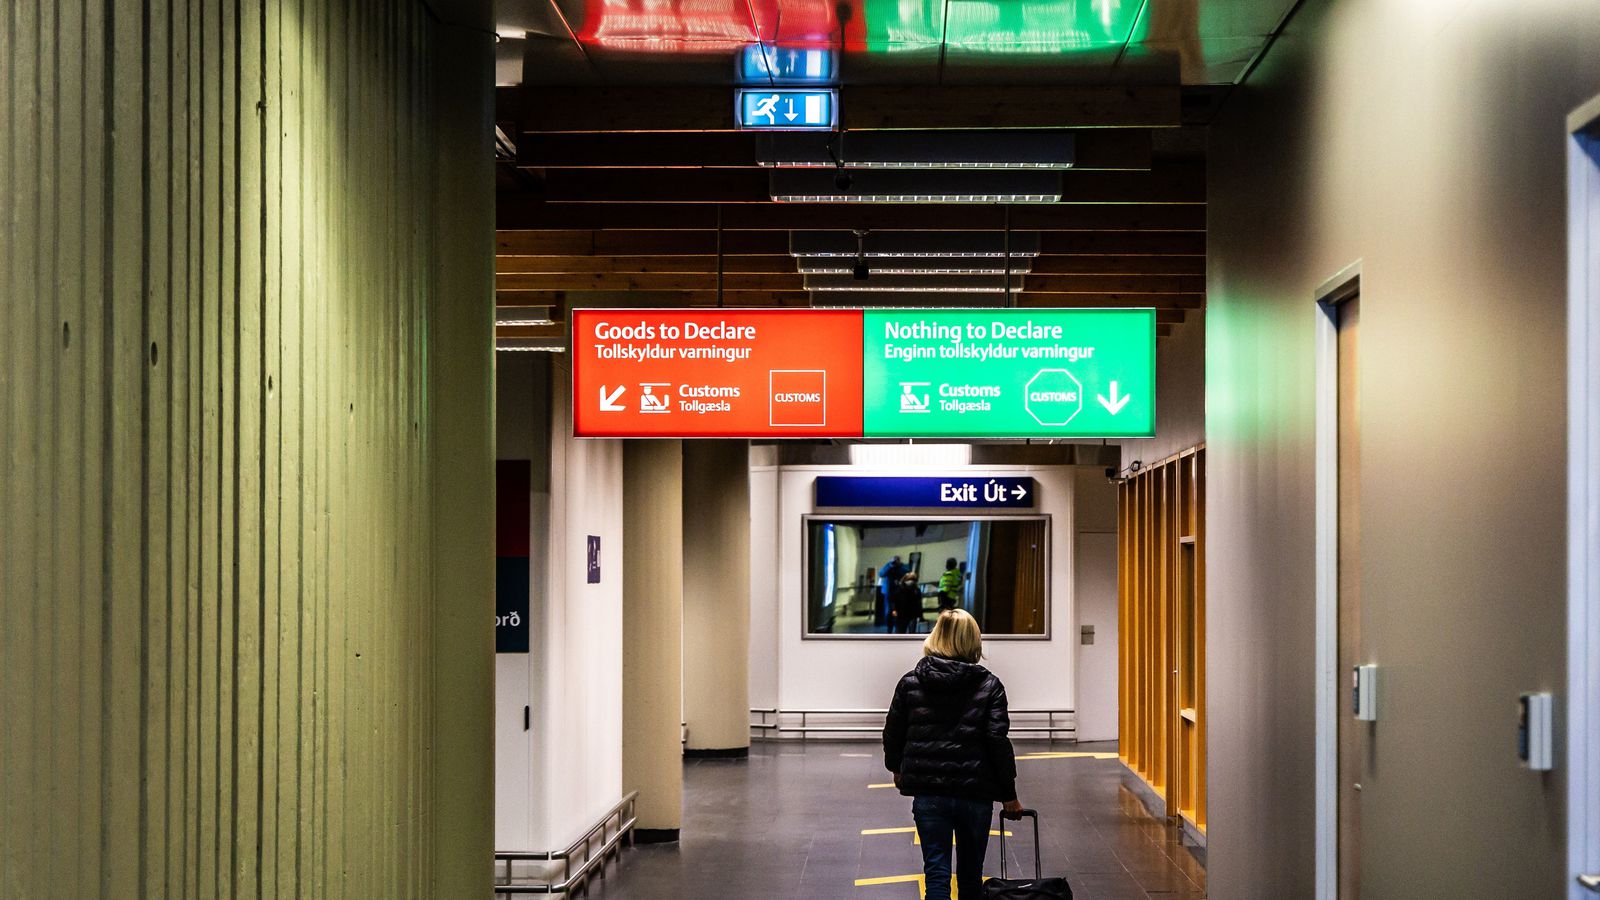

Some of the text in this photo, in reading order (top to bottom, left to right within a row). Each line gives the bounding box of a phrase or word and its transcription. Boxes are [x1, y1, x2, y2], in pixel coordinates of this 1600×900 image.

[594, 321, 756, 340] Goods to Declare
[885, 321, 1063, 343] Nothing to Declare
[595, 344, 752, 362] Tollskyldur varningur
[885, 343, 1095, 362] Enginn tollskyldur varningur
[679, 384, 741, 398] Customs
[939, 384, 1001, 397] Customs
[1030, 392, 1077, 402] CUSTOMS
[775, 393, 821, 403] CUSTOMS
[679, 400, 731, 414] Tollgæsla
[939, 400, 991, 413] Tollgæsla
[940, 479, 1007, 502] Exit Út
